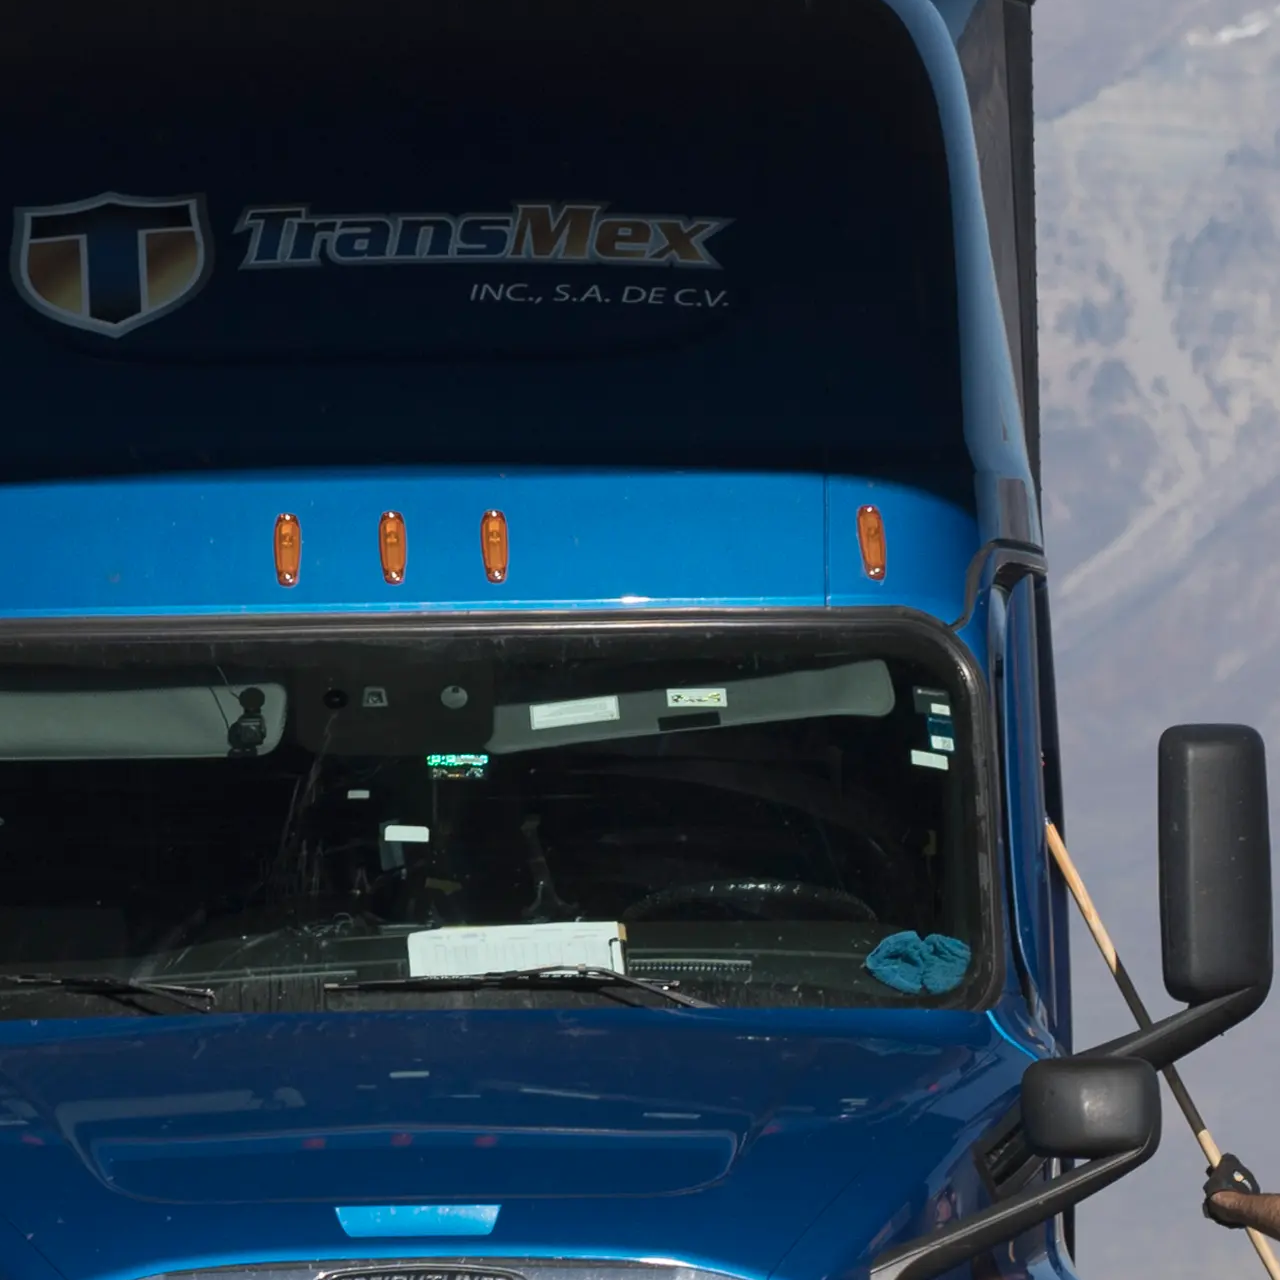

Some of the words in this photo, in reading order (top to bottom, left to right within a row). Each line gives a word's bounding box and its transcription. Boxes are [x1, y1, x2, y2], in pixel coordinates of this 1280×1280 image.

[236, 201, 731, 268] TransMex
[470, 283, 543, 304] INC.,
[553, 284, 611, 303] S.A.
[621, 285, 667, 304] DE
[673, 287, 729, 307] C.V.
